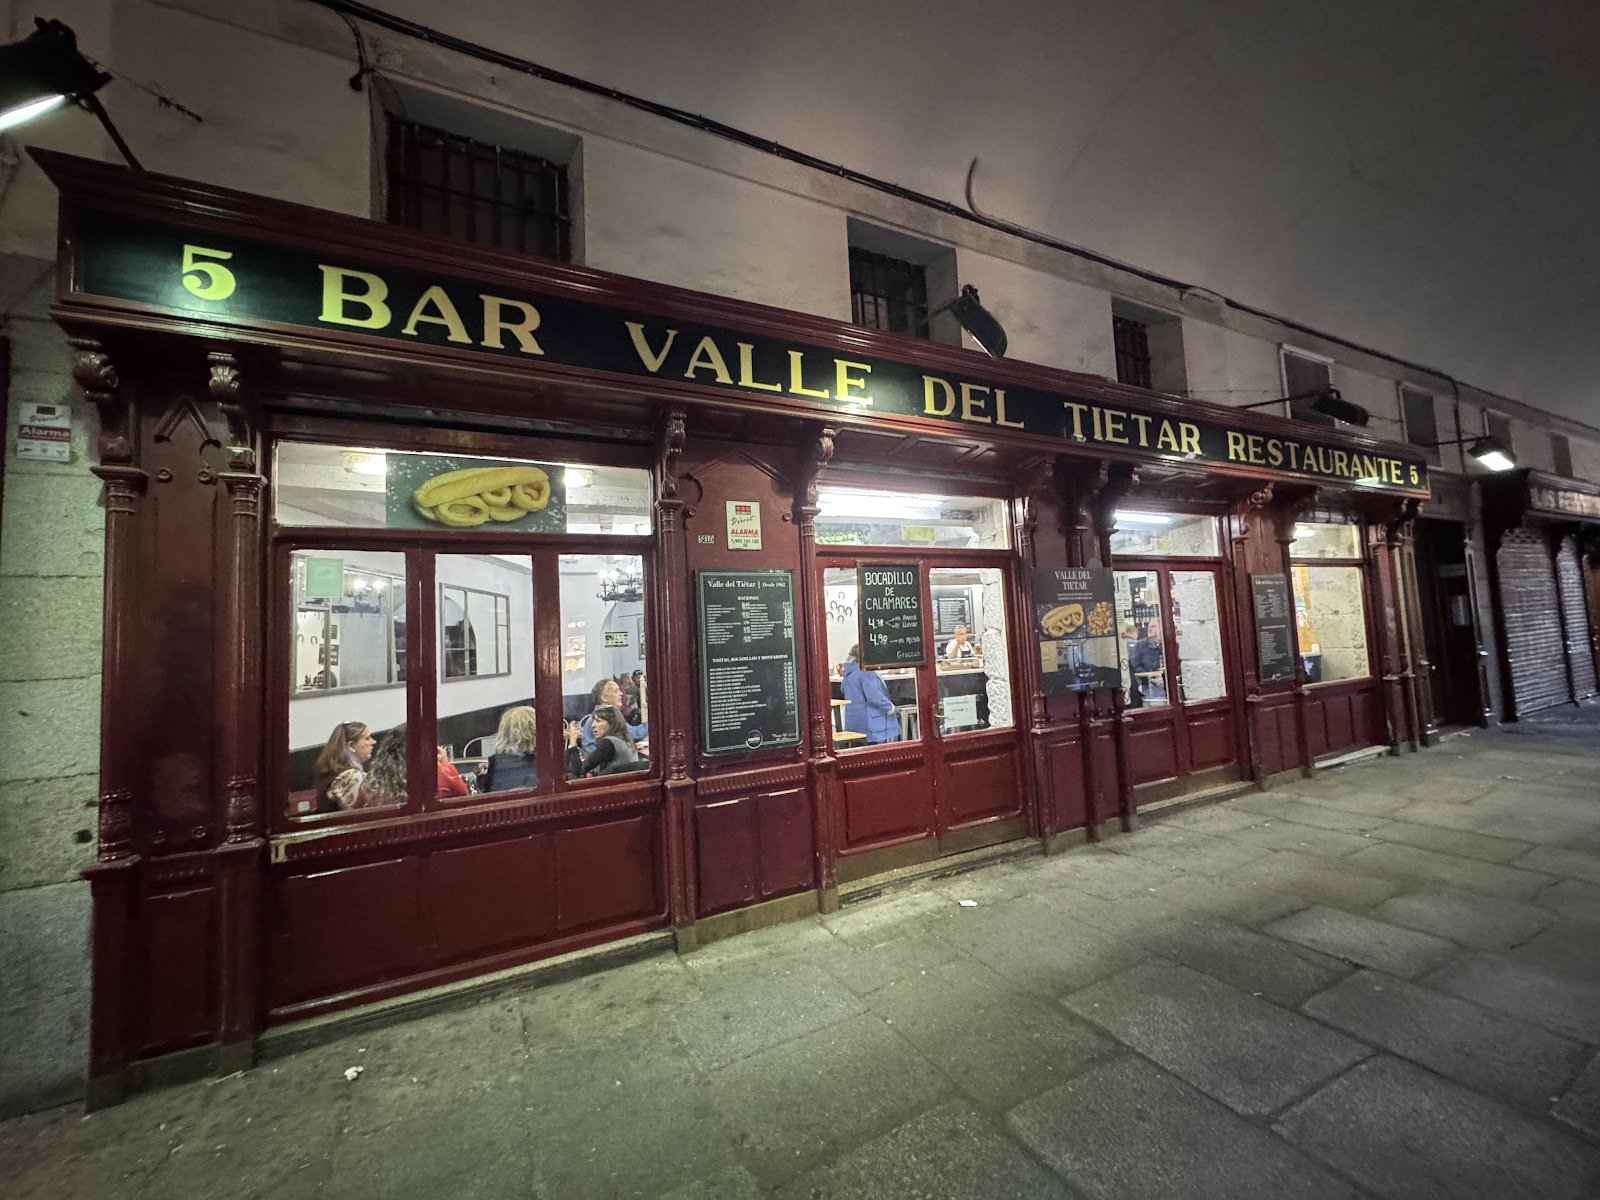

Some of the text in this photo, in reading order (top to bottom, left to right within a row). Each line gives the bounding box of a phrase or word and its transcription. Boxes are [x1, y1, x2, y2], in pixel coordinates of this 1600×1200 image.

[180, 244, 1419, 485] 5 BAR VALLE DEL TIETAR RESTAURANTE 5
[21, 427, 70, 437] Alarma
[730, 528, 759, 536] ALARMA
[864, 571, 914, 586] BOCADILLO
[1054, 570, 1092, 580] VALLE DEL
[707, 580, 724, 588] Valle
[725, 580, 735, 588] del
[736, 580, 756, 588] Tiétar
[1062, 581, 1088, 591] TIETAR
[885, 587, 895, 596] DE
[865, 596, 918, 610] CALAMARES
